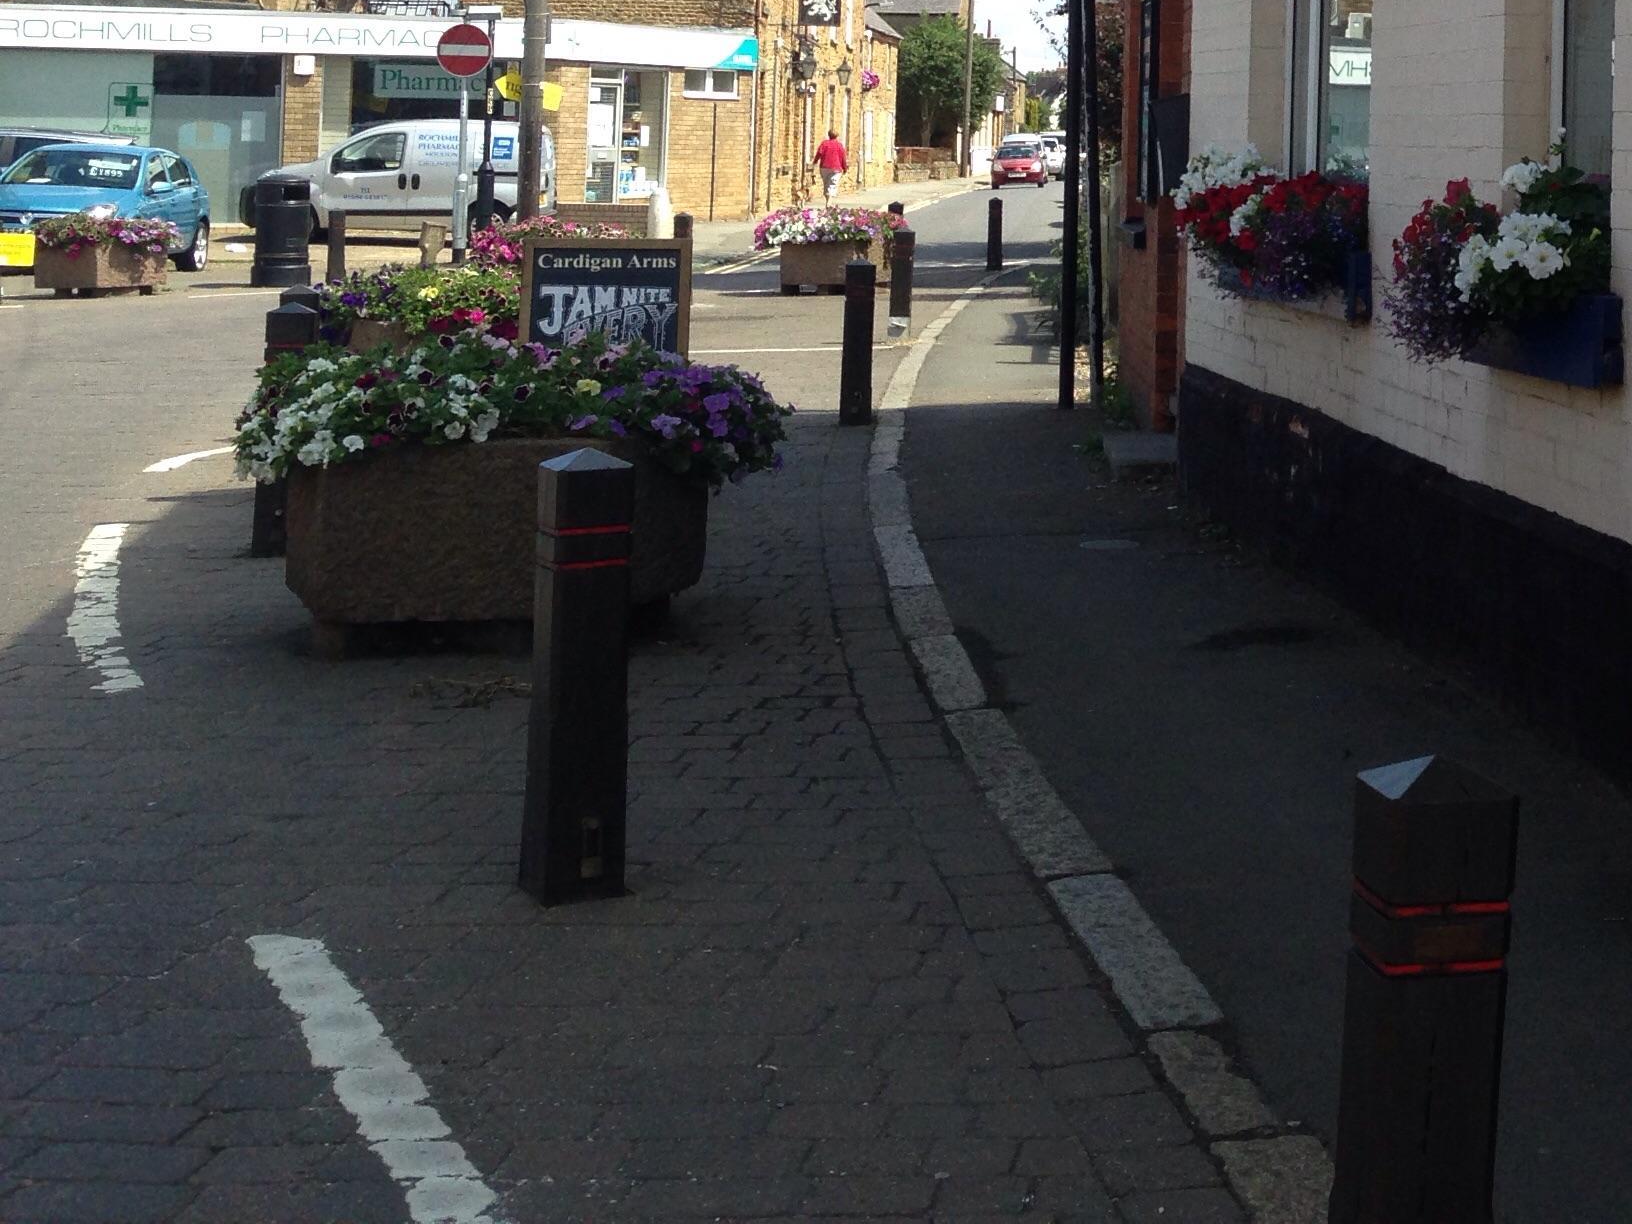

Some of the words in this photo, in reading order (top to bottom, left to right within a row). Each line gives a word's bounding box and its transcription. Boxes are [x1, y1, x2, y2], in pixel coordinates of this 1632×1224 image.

[0, 19, 213, 43] ROCHMILLS
[261, 25, 446, 48] PHARMAC
[381, 69, 488, 96] Pharmc
[538, 253, 622, 272] Cardigan
[627, 255, 677, 269] Arms
[537, 285, 619, 336] JAM
[621, 286, 673, 308] NITE
